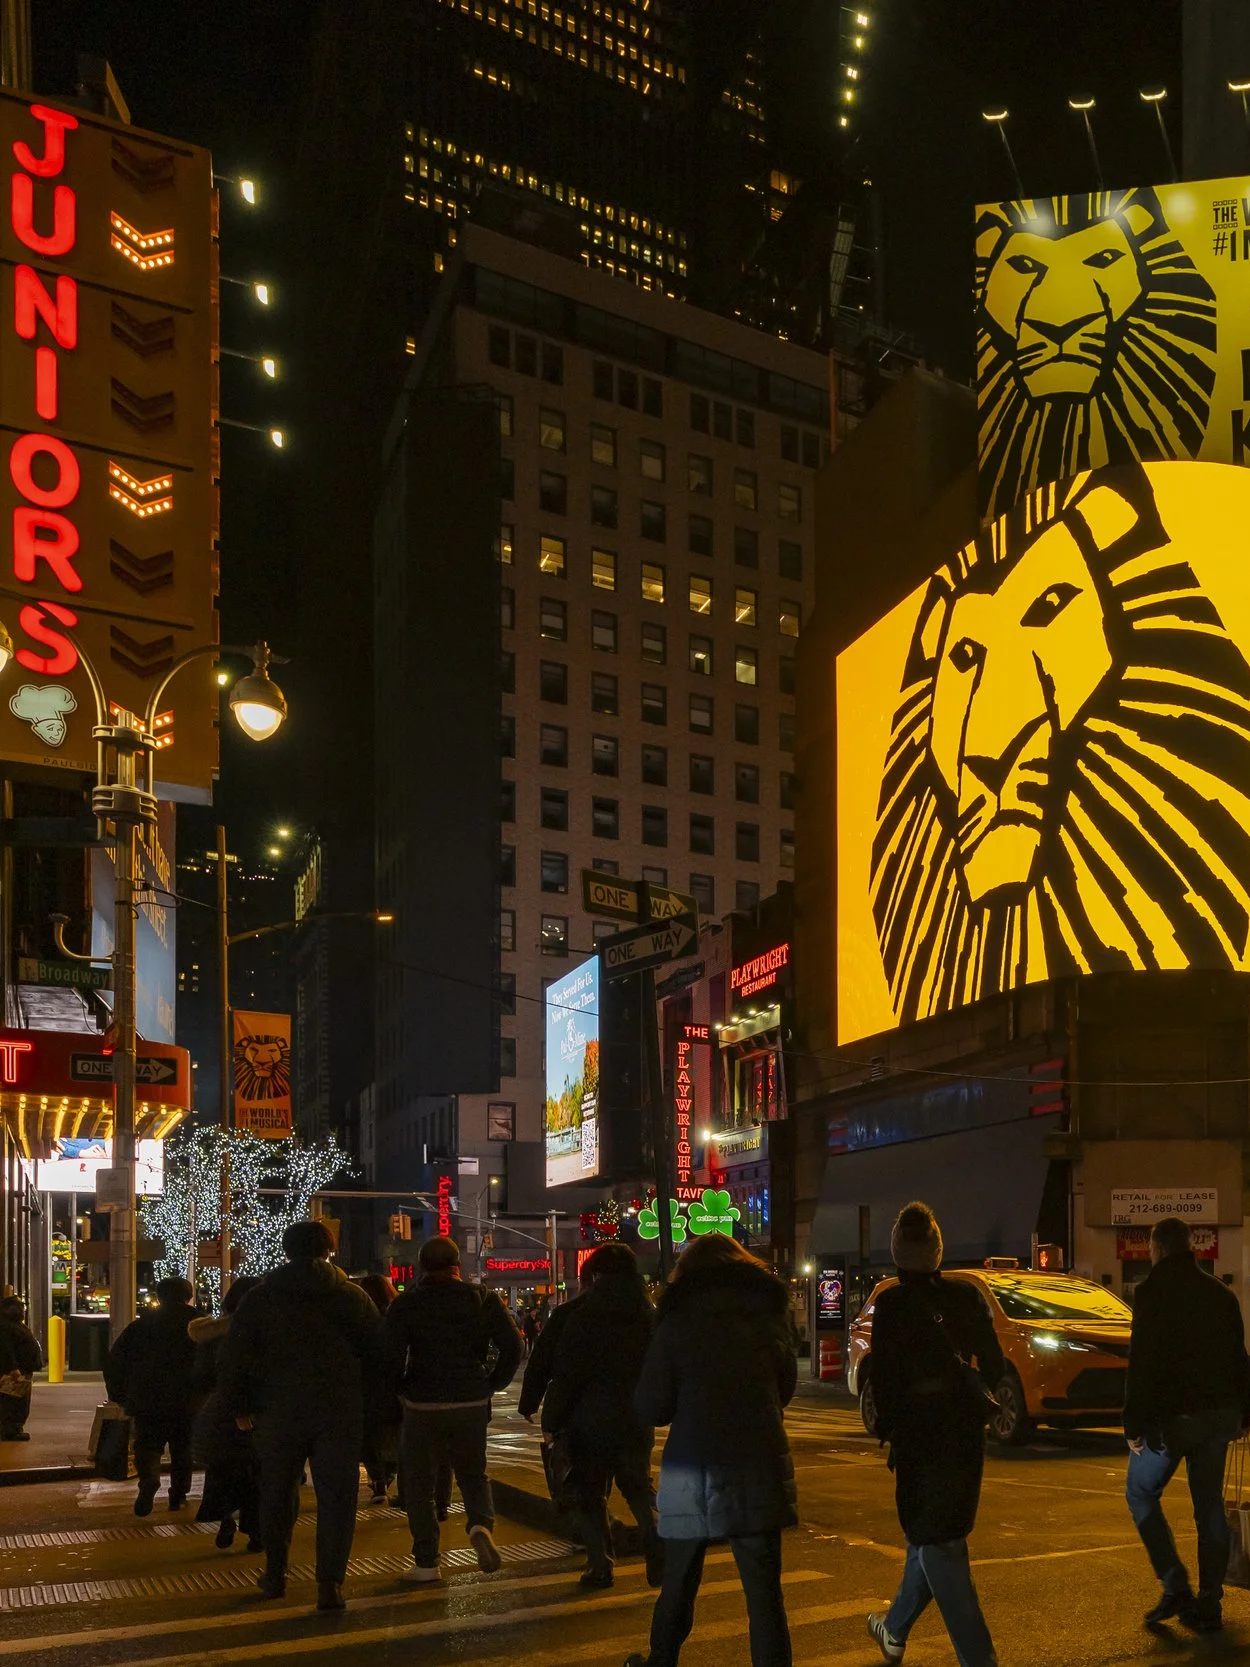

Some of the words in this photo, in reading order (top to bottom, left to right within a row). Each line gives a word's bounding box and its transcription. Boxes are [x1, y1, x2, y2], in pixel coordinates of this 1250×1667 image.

[1213, 204, 1238, 224] THE
[1213, 230, 1238, 262] #1
[11, 104, 82, 676] JUNIORS
[594, 885, 630, 909] ONE
[651, 898, 683, 917] WAY
[608, 942, 635, 965] ONE
[651, 928, 683, 952] WAY
[38, 961, 109, 987] Broadway
[731, 943, 789, 989] PLAYWRIGHT
[562, 979, 577, 1001] Served
[577, 977, 585, 992] For
[741, 971, 777, 998] RESTAURANT
[684, 1026, 709, 1039] THE
[81, 1062, 111, 1074] ONE
[249, 1118, 289, 1129] MUSICAL
[675, 1042, 692, 1183] PLAYWRIGHT
[437, 1175, 453, 1238] uperdry.
[1112, 1193, 1151, 1201] RETAIL
[1179, 1192, 1216, 1200] LEASE
[1129, 1203, 1203, 1213] 212-689-0099
[486, 1258, 539, 1272] Superdry
